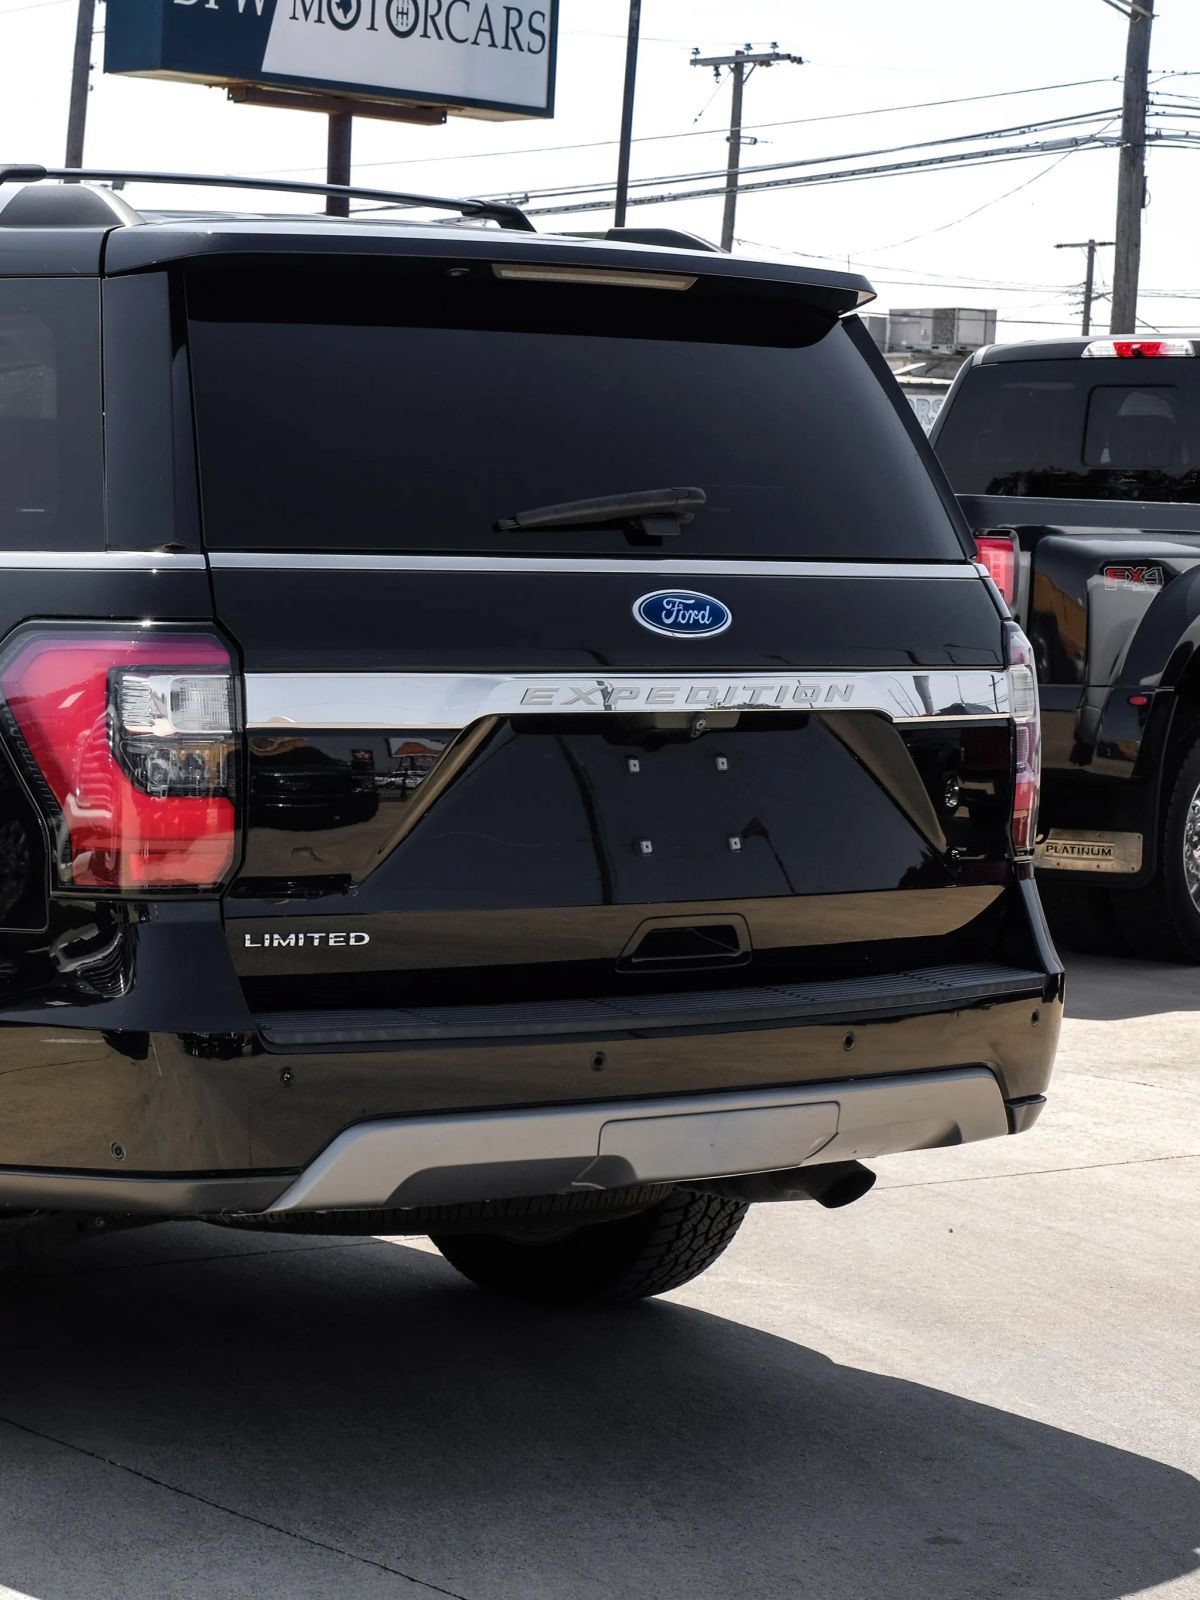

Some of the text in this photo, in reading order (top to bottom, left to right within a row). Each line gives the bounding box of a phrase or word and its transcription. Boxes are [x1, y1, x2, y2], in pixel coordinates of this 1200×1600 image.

[1103, 566, 1164, 592] FX4
[661, 597, 713, 625] Ford
[519, 684, 856, 706] EXPEDITION
[1045, 844, 1113, 857] PLATINUM
[244, 932, 371, 948] LIMITED
